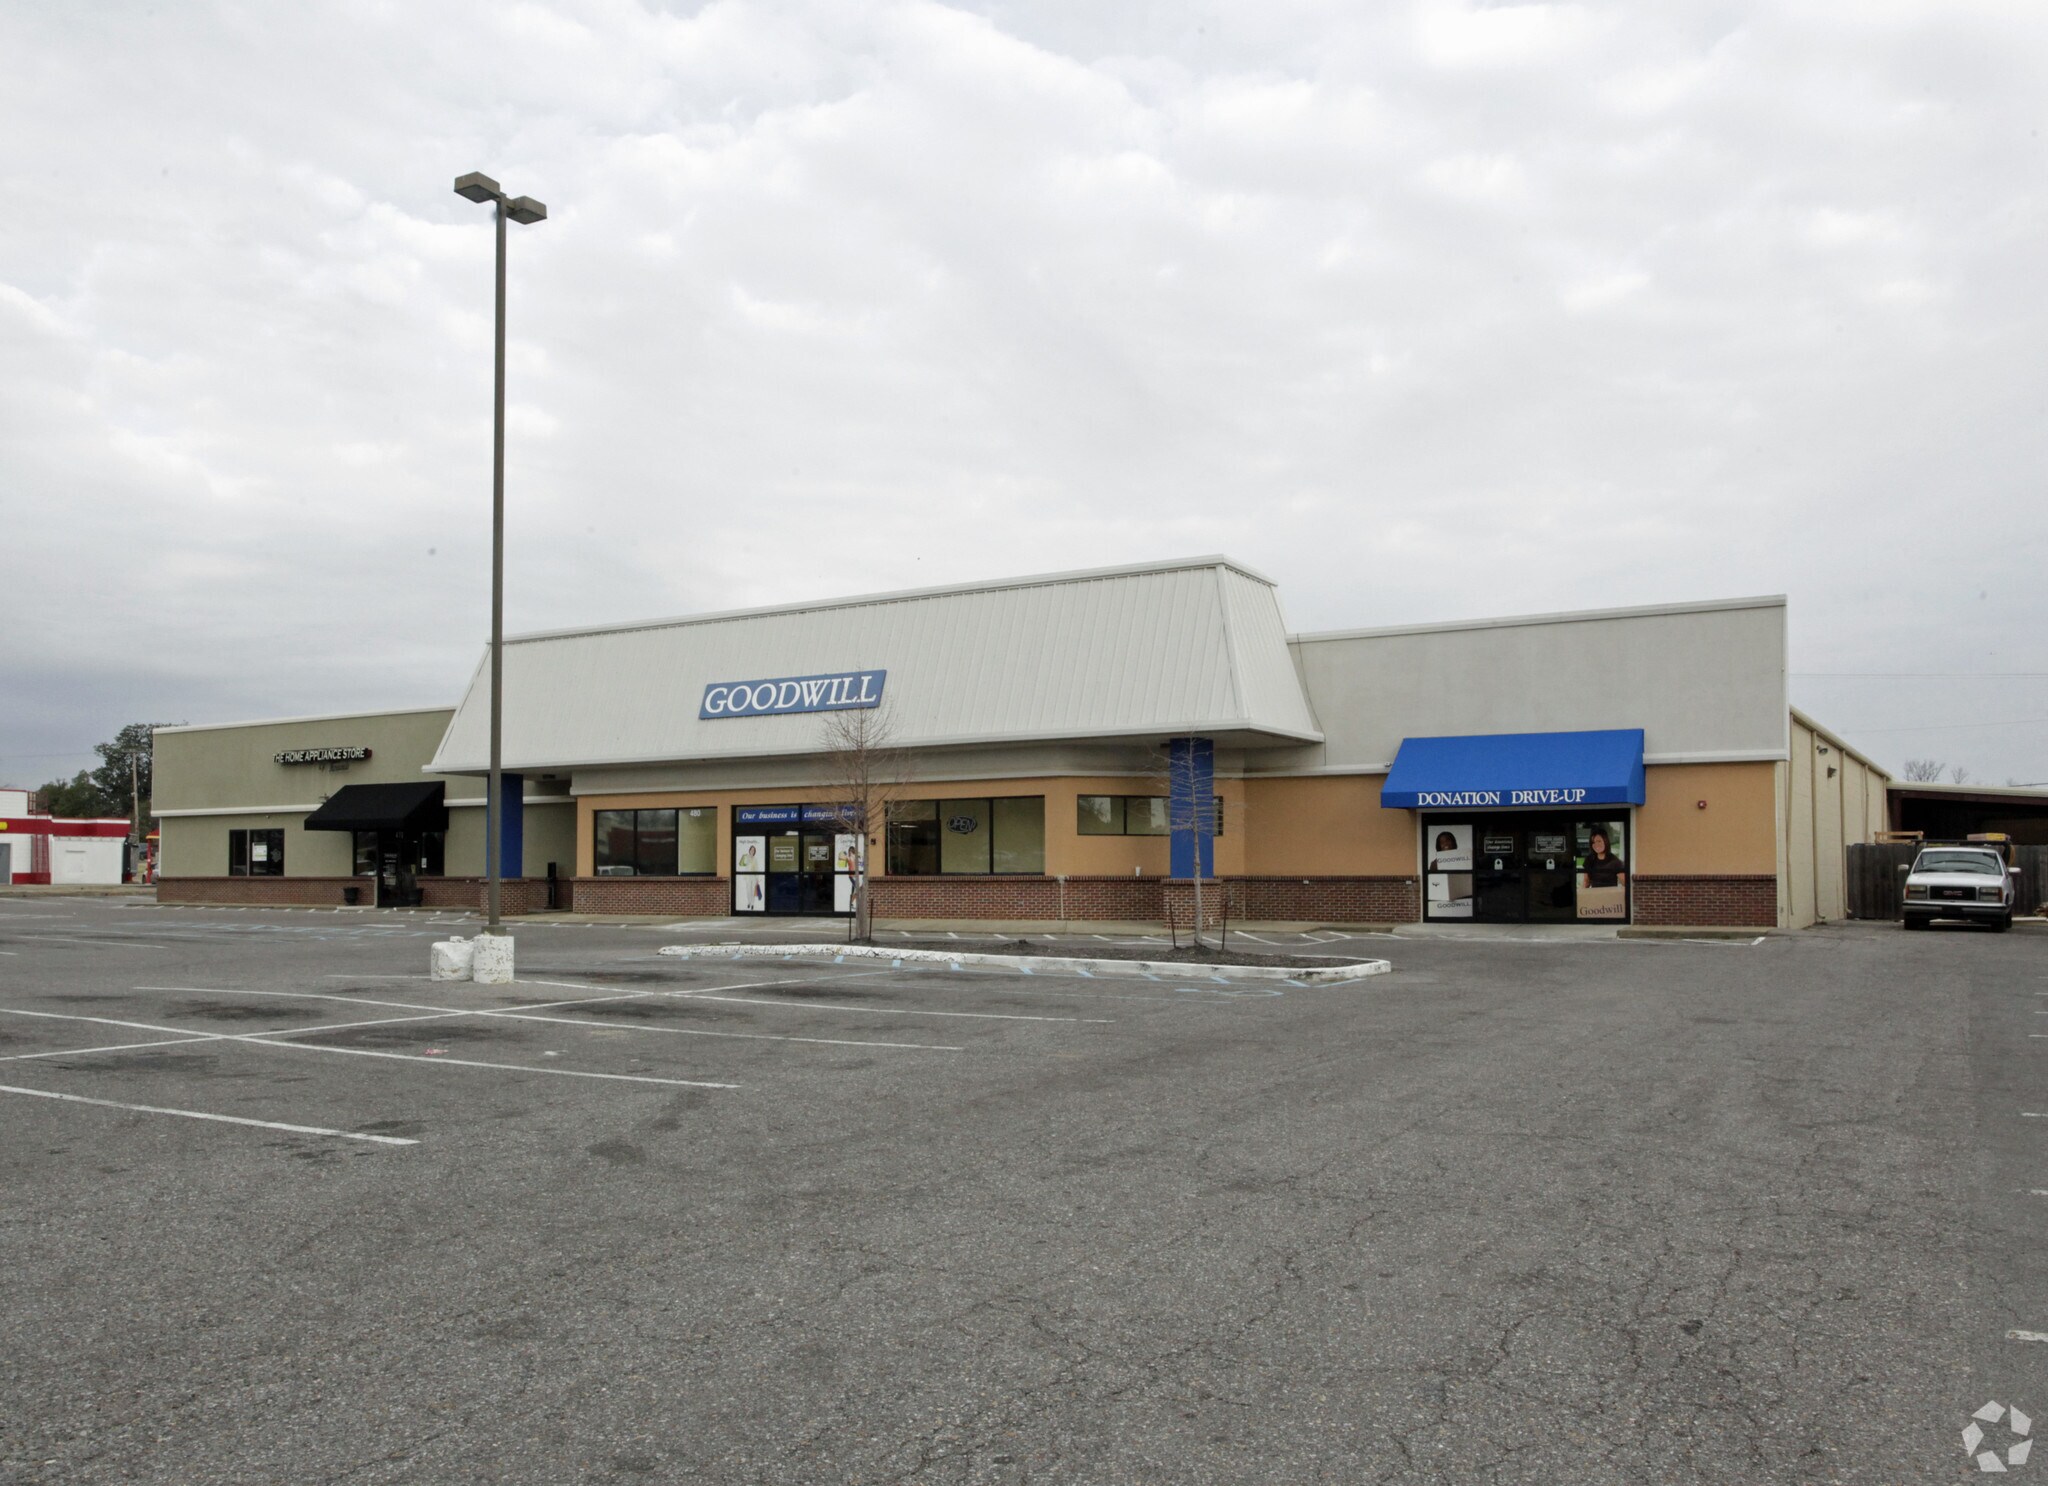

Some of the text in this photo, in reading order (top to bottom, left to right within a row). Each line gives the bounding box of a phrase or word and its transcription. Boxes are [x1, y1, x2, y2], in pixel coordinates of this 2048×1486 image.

[704, 675, 877, 714] GOODWILL
[273, 747, 365, 763] THE HOME APPLIANCE STORE
[1418, 788, 1586, 806] DONATION DRIVE-UP
[742, 812, 756, 820] Our
[758, 811, 788, 819] business
[948, 816, 976, 831] OPEN
[1437, 856, 1472, 864] GOODWILL
[1580, 903, 1624, 916] Goodwill
